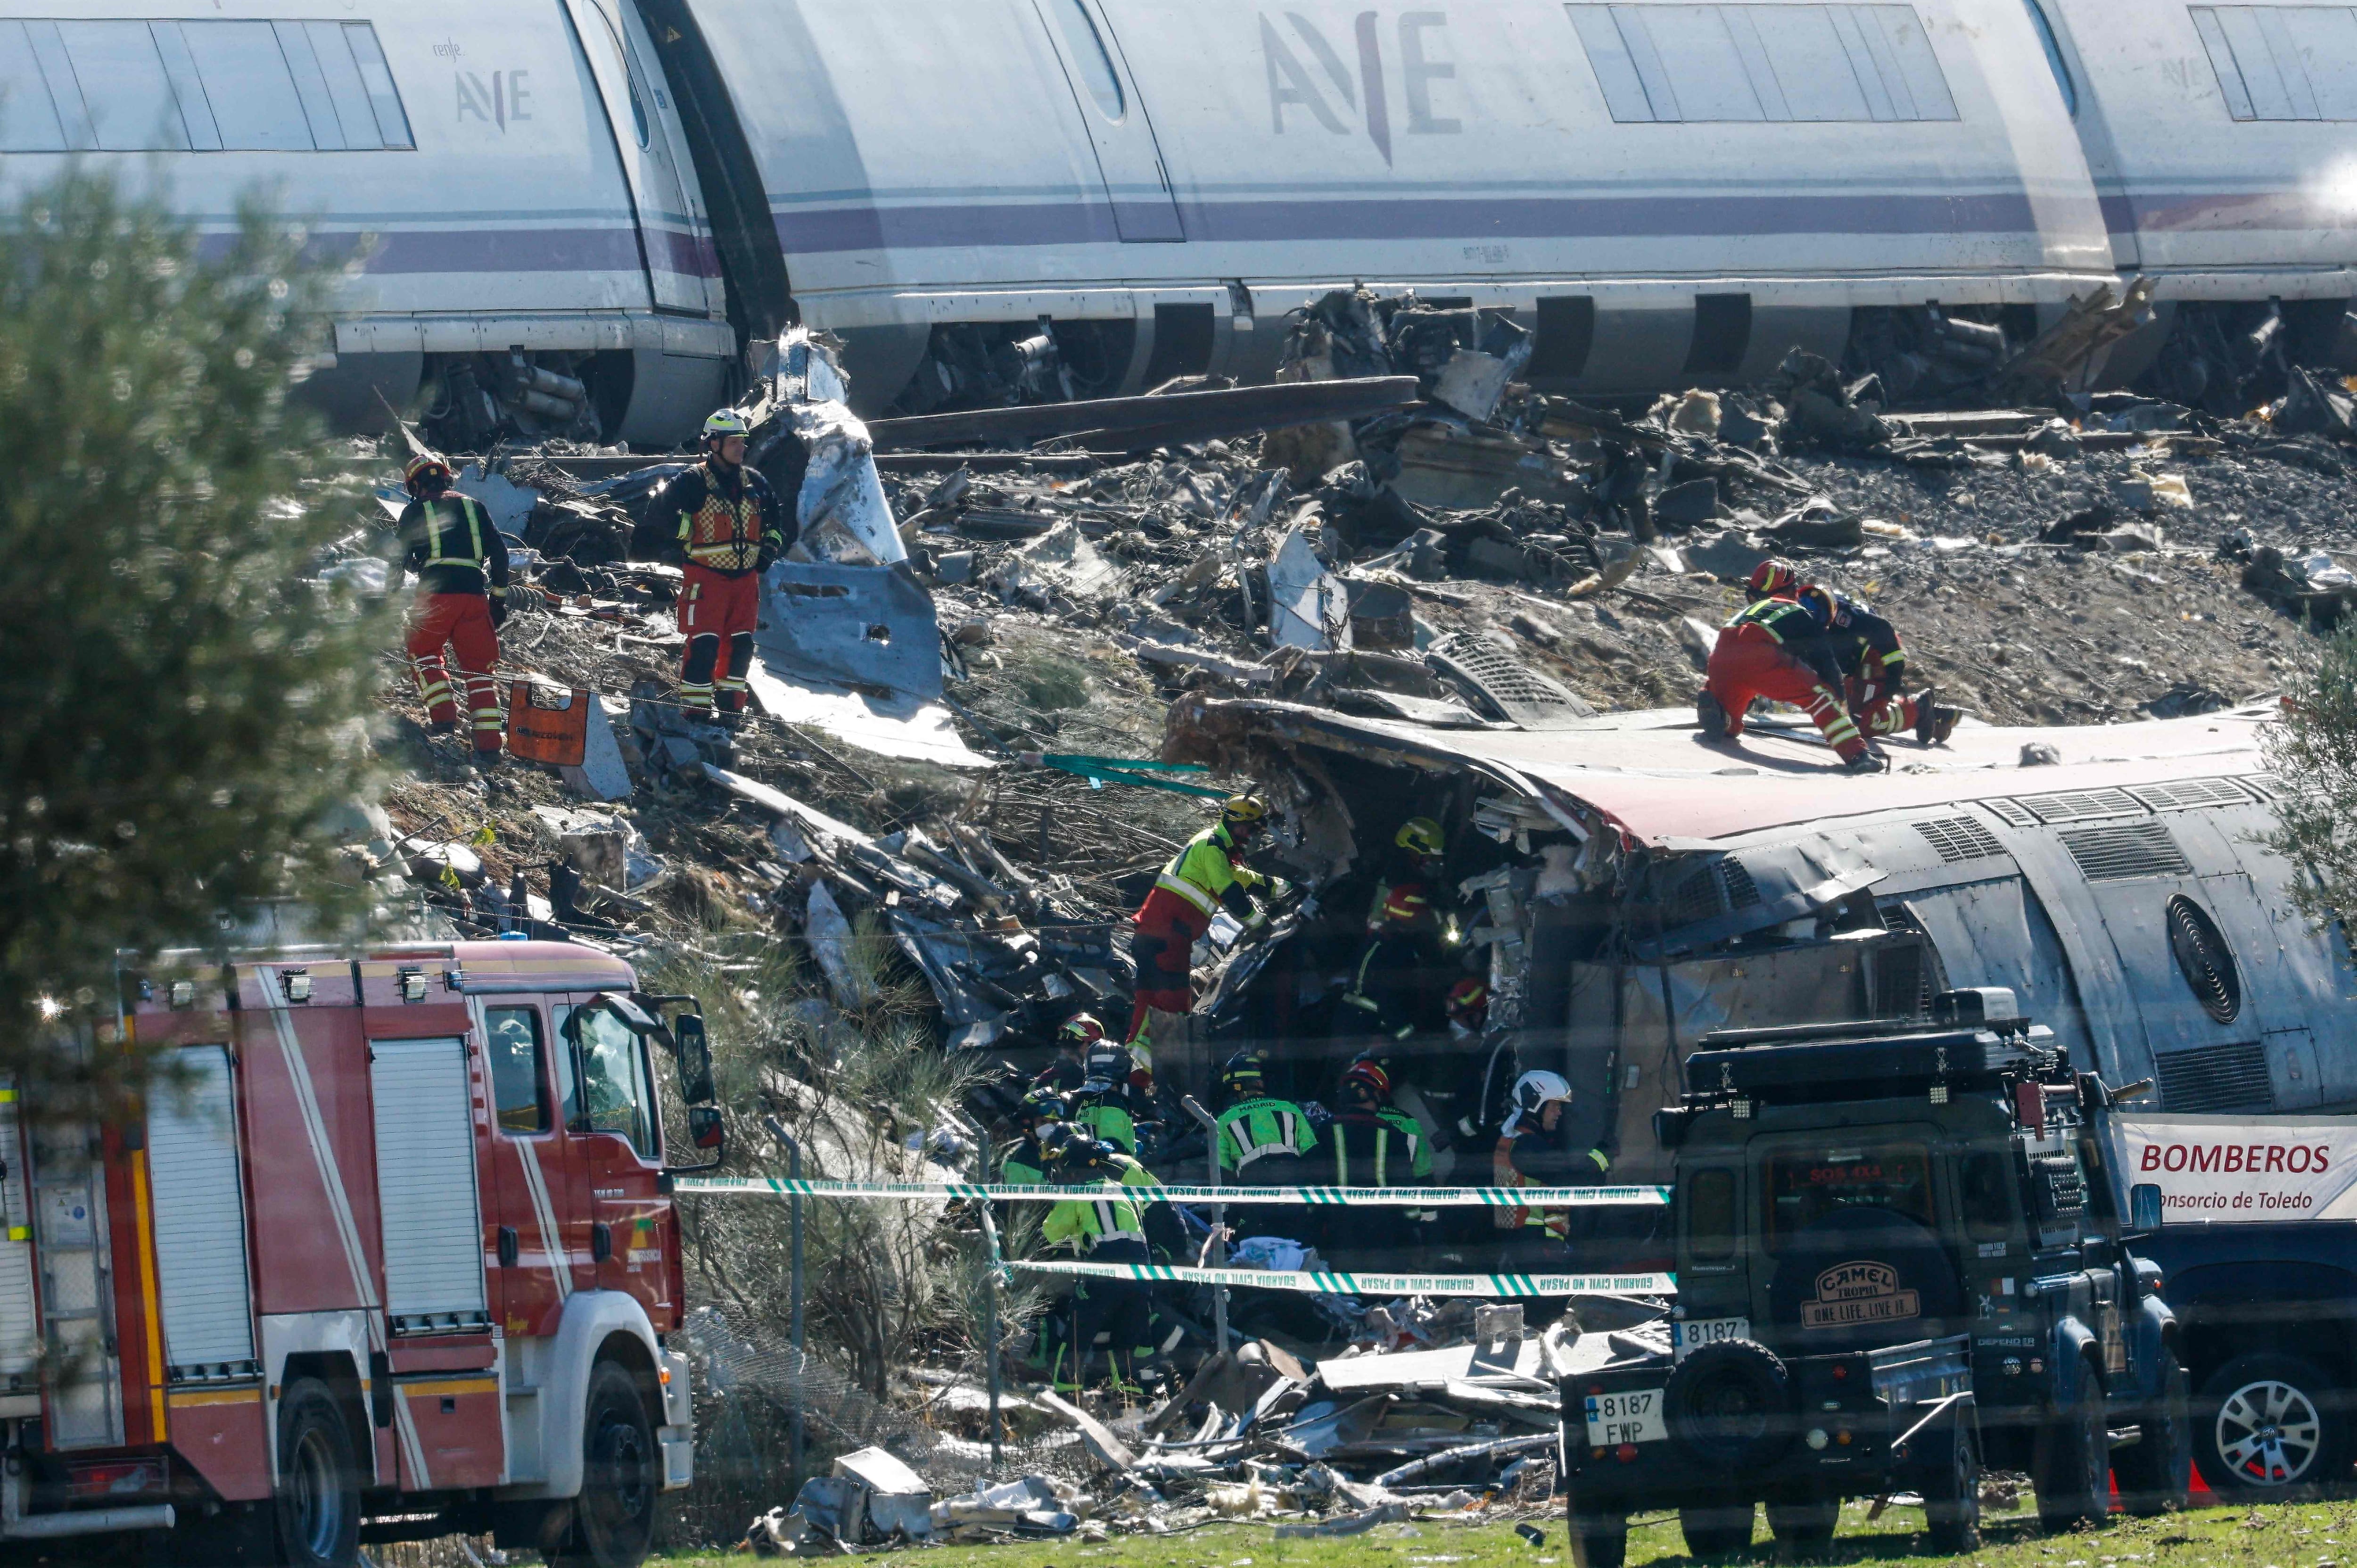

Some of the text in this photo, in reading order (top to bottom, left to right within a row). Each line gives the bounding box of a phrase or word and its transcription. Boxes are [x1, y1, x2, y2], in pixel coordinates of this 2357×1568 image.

[433, 37, 461, 63] renfe
[1259, 10, 1461, 170] AVE
[455, 70, 532, 135] AVE
[1239, 1102, 1276, 1112] MADRID
[2141, 1145, 2330, 1173] BOMBEROS
[1167, 1186, 1197, 1196] PASAR
[1218, 1188, 1238, 1197] CIVIL
[1242, 1188, 1280, 1197] GUARDIA
[1346, 1189, 1460, 1199] GUARDIA CIVIL NO PASAR
[1525, 1188, 1640, 1200] GUARDIA CIVIL NO PASAR
[2161, 1191, 2312, 1209] onsorcio de Toledo
[1182, 1271, 1296, 1287] GUARDIA CIVIL NO PASAR
[1361, 1278, 1474, 1290] GUARDIA CIVIL NO PASAR
[1540, 1277, 1652, 1290] GUARDIA CIVIL NO PASAR
[1821, 1267, 1892, 1290] CAMEL
[1838, 1286, 1878, 1297] TROPHY
[1815, 1299, 1908, 1322] ONE LIFE. LIVE IT.
[1689, 1321, 1737, 1343] 8187
[1978, 1337, 2035, 1346] DEFENDER
[1604, 1394, 1651, 1417] 8187
[1607, 1422, 1642, 1444] FWP
